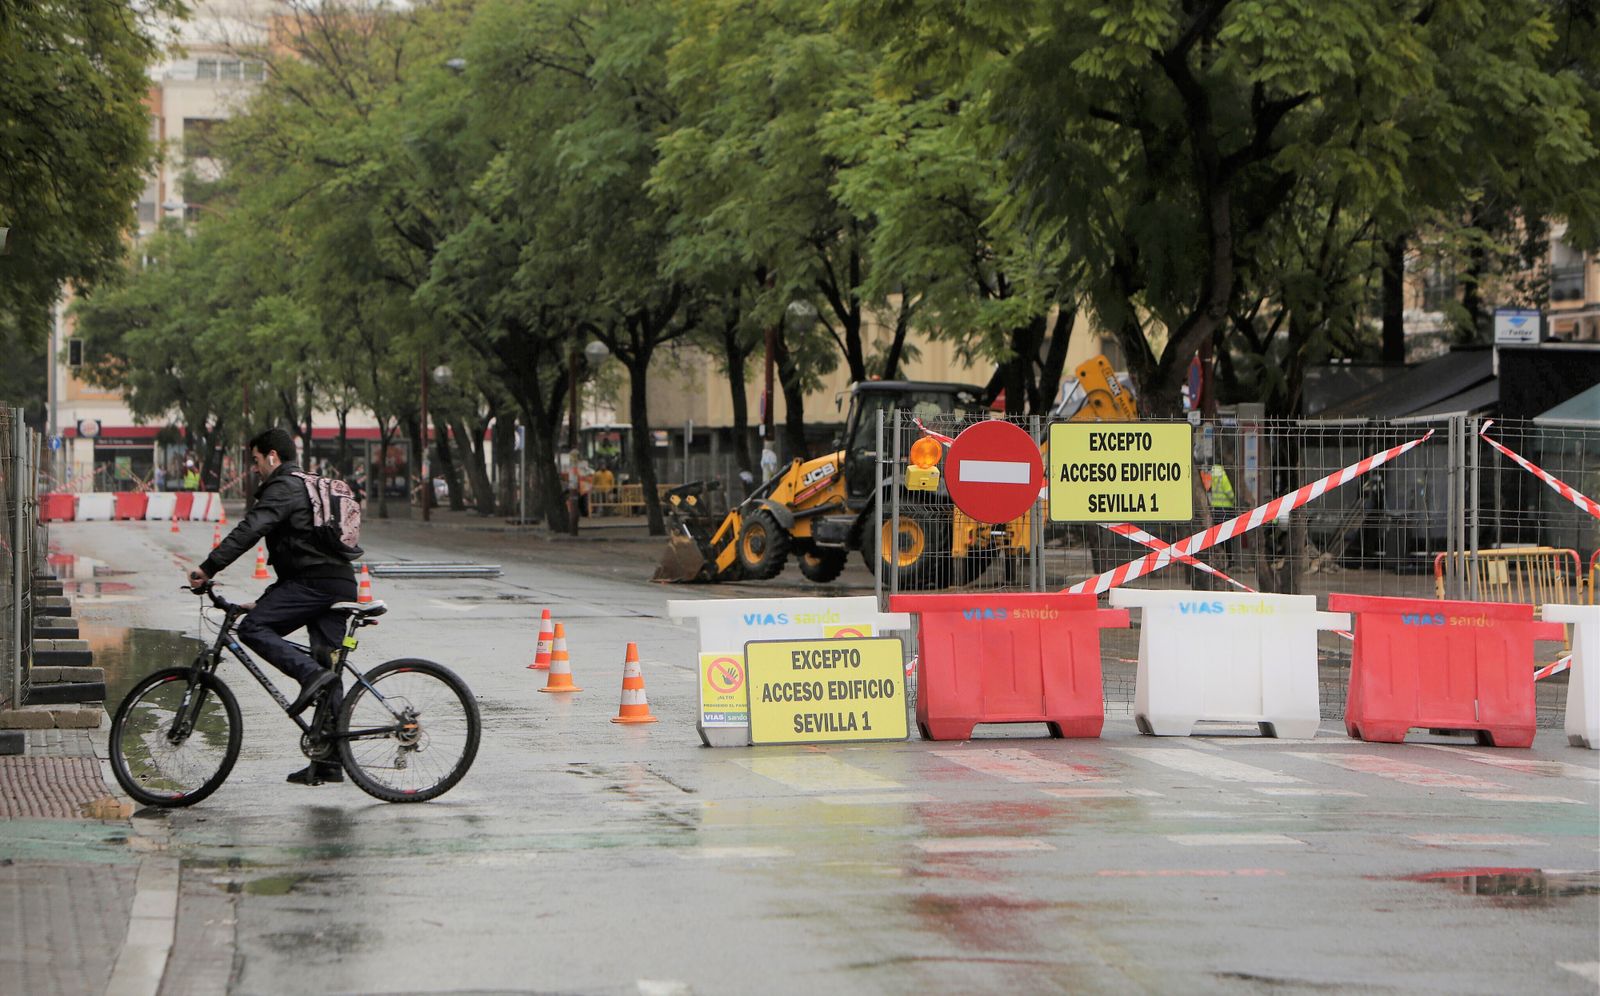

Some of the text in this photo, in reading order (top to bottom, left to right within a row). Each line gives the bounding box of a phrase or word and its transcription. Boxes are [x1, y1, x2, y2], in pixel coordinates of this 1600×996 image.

[1089, 432, 1153, 451] EXCEPTO
[804, 463, 835, 486] JCB
[1060, 462, 1181, 482] ACCESO EDIFICIO
[1088, 493, 1159, 513] SEVILLA 1
[743, 609, 841, 626] VIAS sando
[963, 604, 1059, 621] VIAS sando
[1179, 600, 1275, 616] VIAS sando
[1401, 612, 1495, 628] VIAS sando
[791, 648, 861, 670] EXCEPTO
[762, 678, 895, 703] ACCESO EDIFICIO
[727, 713, 747, 721] sando
[793, 711, 872, 733] SEVILLA 1
